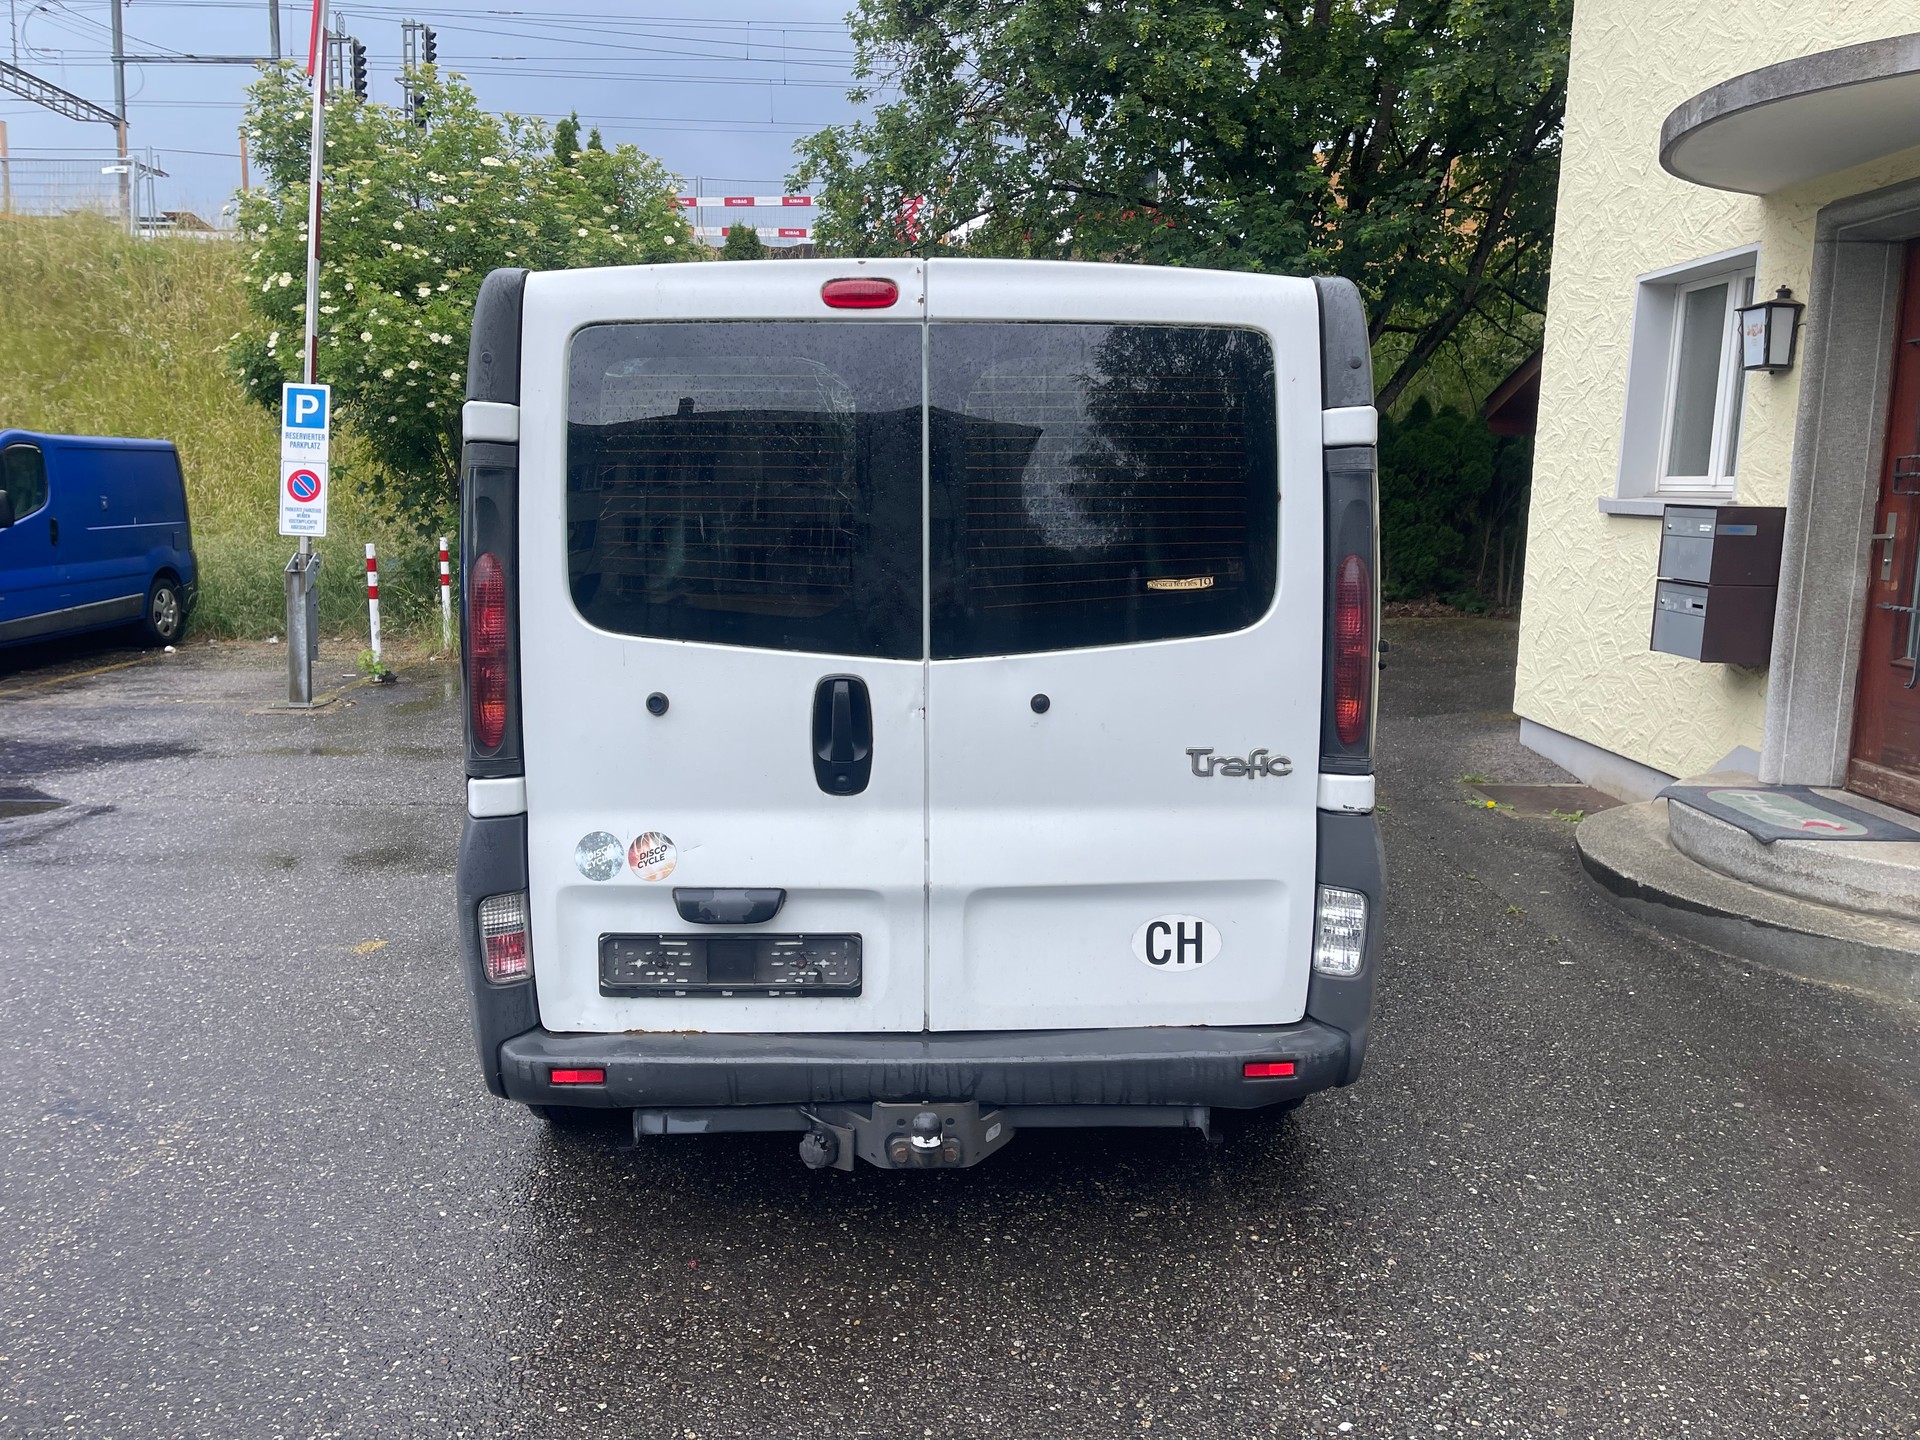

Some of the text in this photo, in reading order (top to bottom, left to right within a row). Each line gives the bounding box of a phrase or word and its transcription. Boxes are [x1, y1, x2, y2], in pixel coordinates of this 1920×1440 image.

[295, 394, 319, 424] P
[285, 432, 325, 441] RESERVIERTER
[289, 441, 321, 449] PARKPLATZ
[1186, 747, 1293, 779] Trafic
[637, 853, 665, 869] CYCLE
[639, 844, 668, 861] DISCO
[1146, 921, 1203, 965] CH
